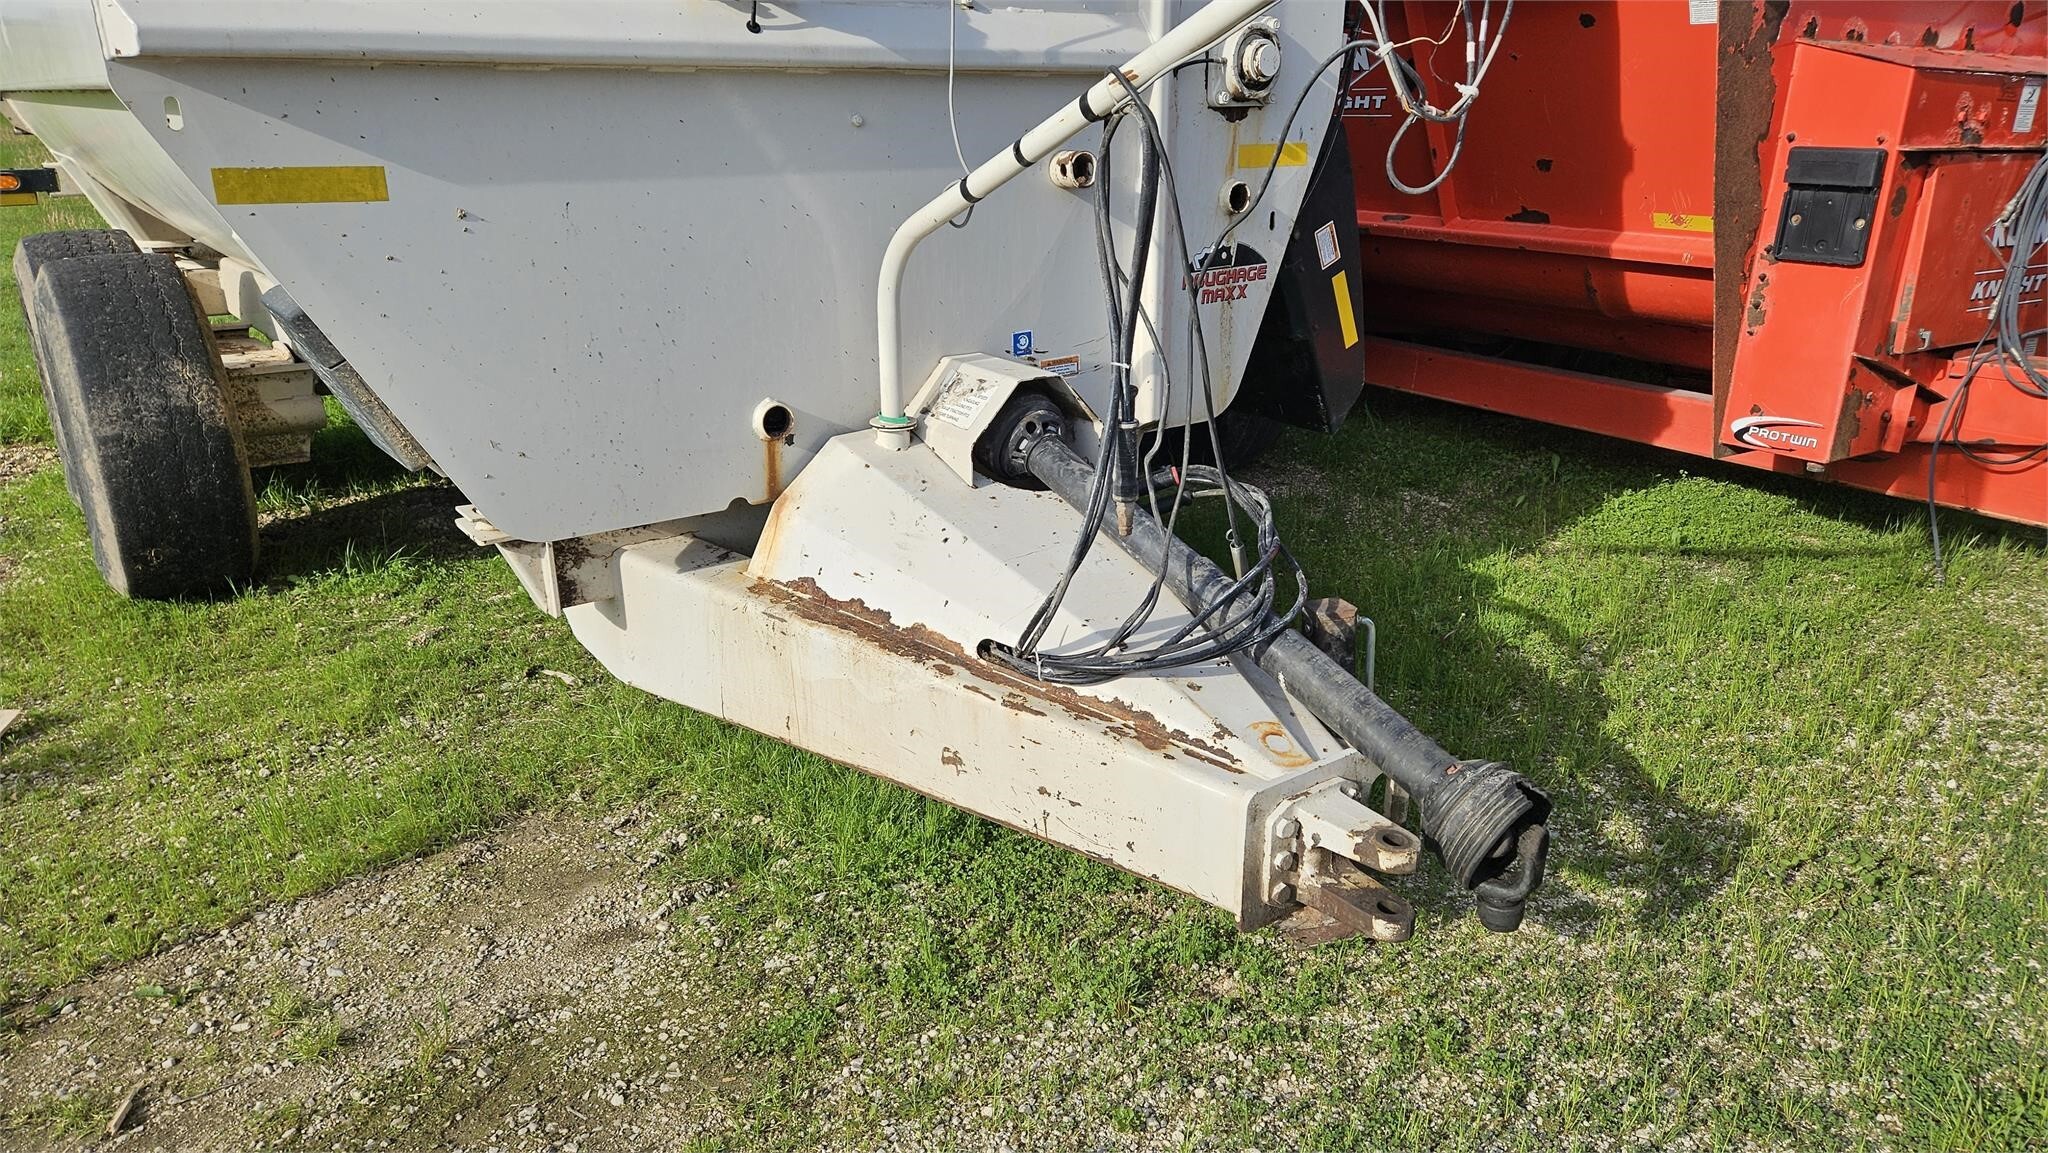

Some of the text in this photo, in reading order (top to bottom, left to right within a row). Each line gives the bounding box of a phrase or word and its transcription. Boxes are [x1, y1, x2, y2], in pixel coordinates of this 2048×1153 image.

[1344, 95, 1386, 110] GHT
[1201, 284, 1248, 305] MAXX
[1971, 274, 2046, 300] KNHT
[1749, 426, 1817, 448] PROTWIN
